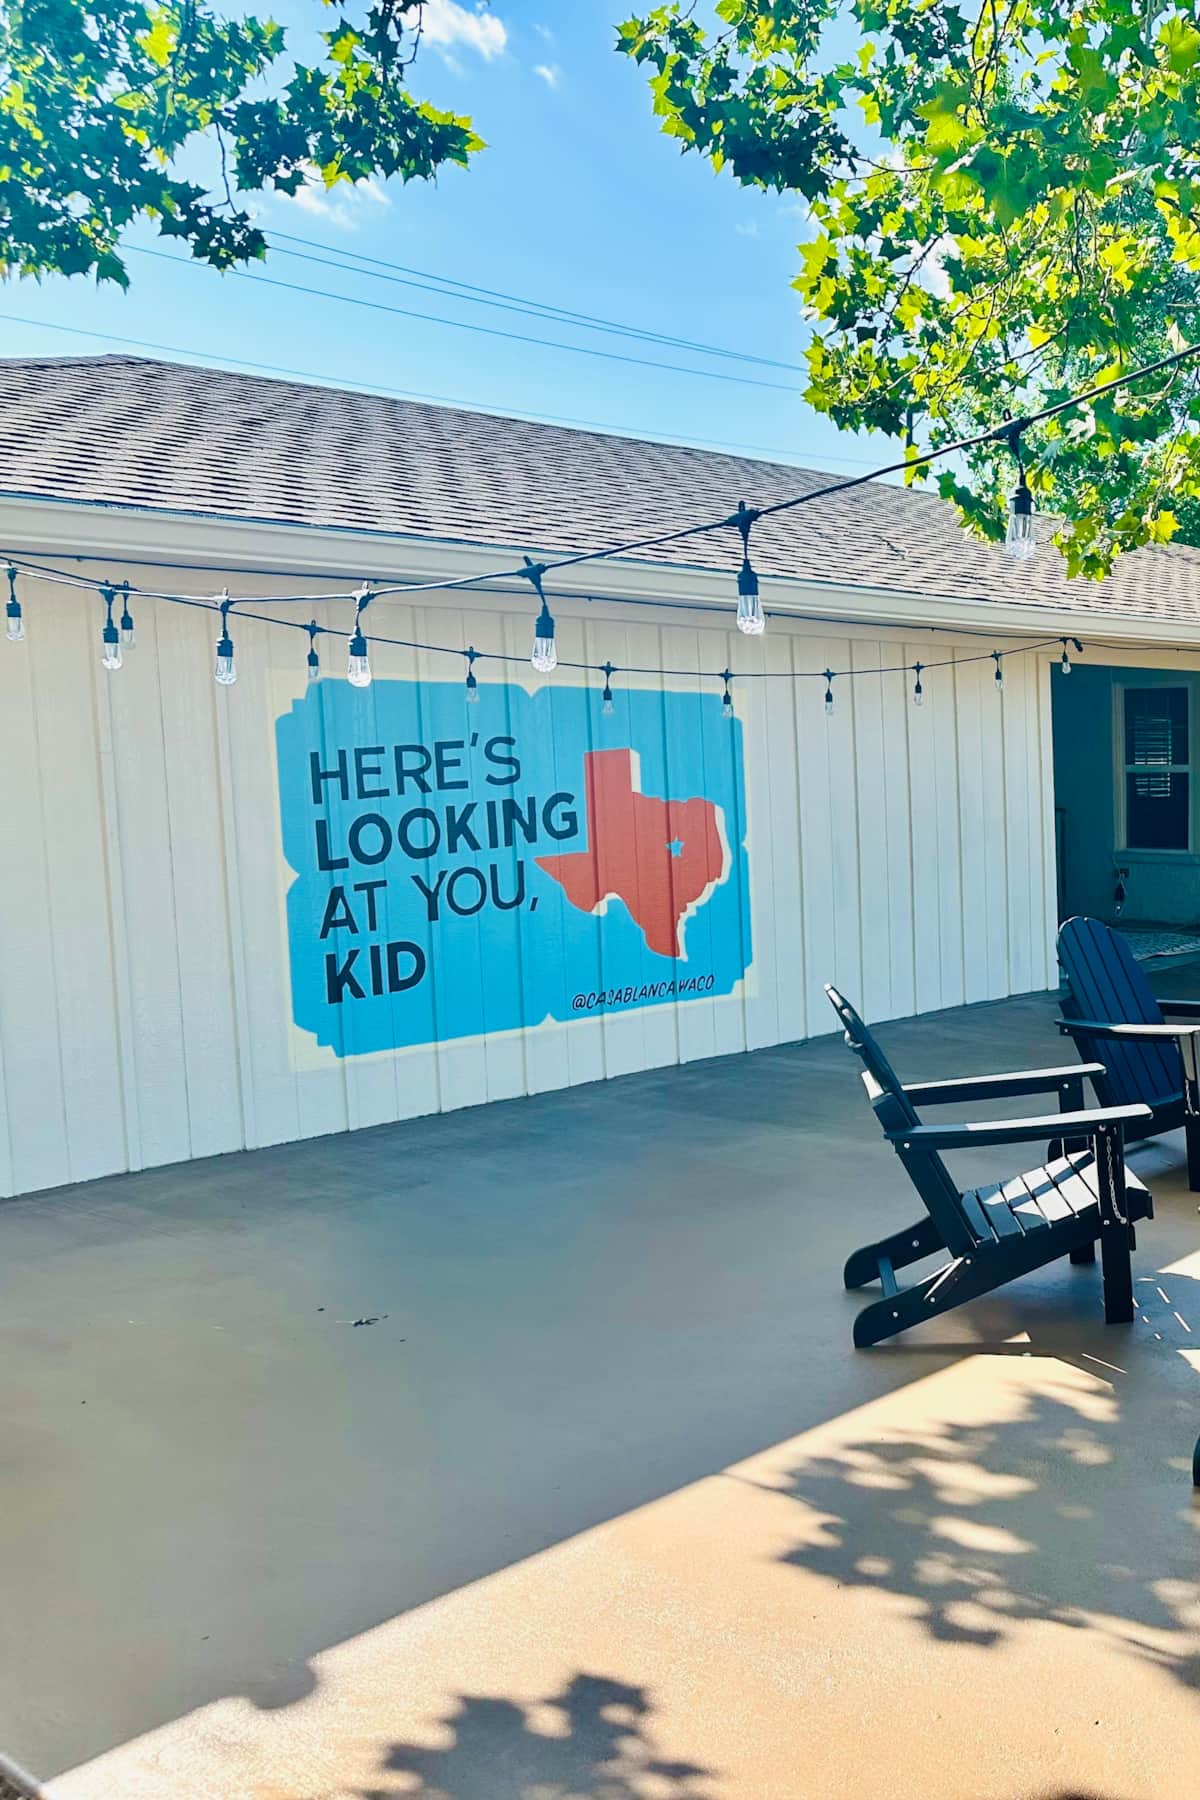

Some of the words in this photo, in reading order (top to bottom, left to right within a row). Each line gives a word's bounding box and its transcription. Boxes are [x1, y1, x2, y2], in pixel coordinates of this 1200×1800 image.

[309, 733, 520, 804] HERE'S
[314, 792, 578, 871] LOOKING
[320, 880, 387, 939] AT
[411, 860, 539, 922] YOU,
[325, 940, 426, 1004] KID
